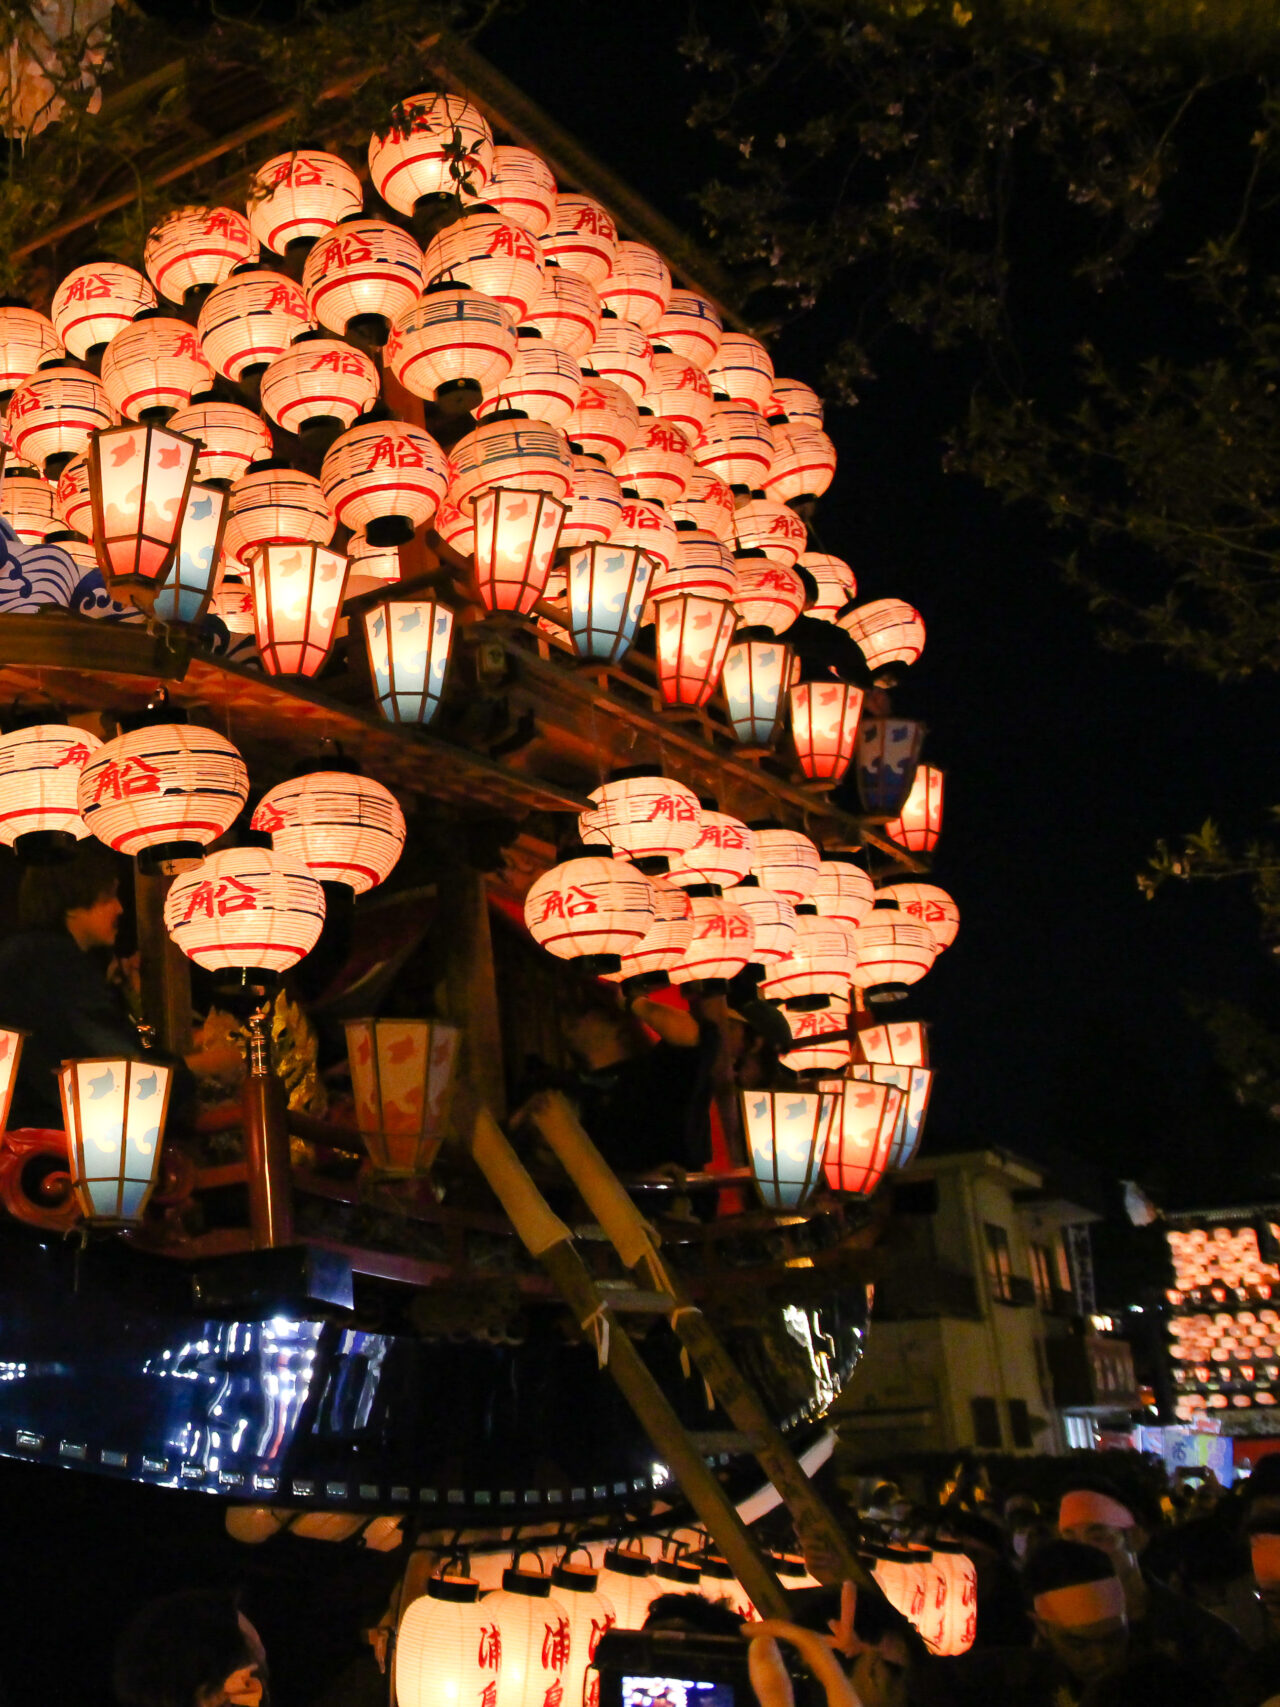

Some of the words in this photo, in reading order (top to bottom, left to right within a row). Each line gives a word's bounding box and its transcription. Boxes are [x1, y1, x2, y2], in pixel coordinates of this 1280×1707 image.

[273, 159, 326, 190] 船
[203, 211, 252, 247] 船
[573, 206, 616, 240] 船
[322, 232, 375, 276] 船
[485, 223, 537, 264] 船
[63, 273, 117, 307] 船
[265, 282, 312, 322] 船
[311, 350, 366, 378] 船
[677, 366, 713, 400] 船
[9, 386, 44, 420] 船
[366, 435, 425, 471] 船
[647, 424, 692, 454] 船
[770, 514, 807, 540] 船
[757, 569, 799, 595] 船
[93, 756, 162, 803] 船
[649, 794, 697, 824] 船
[696, 825, 747, 852] 船
[184, 876, 262, 924] 船
[540, 886, 600, 925] 船
[907, 899, 949, 923] 船
[697, 914, 751, 941] 船
